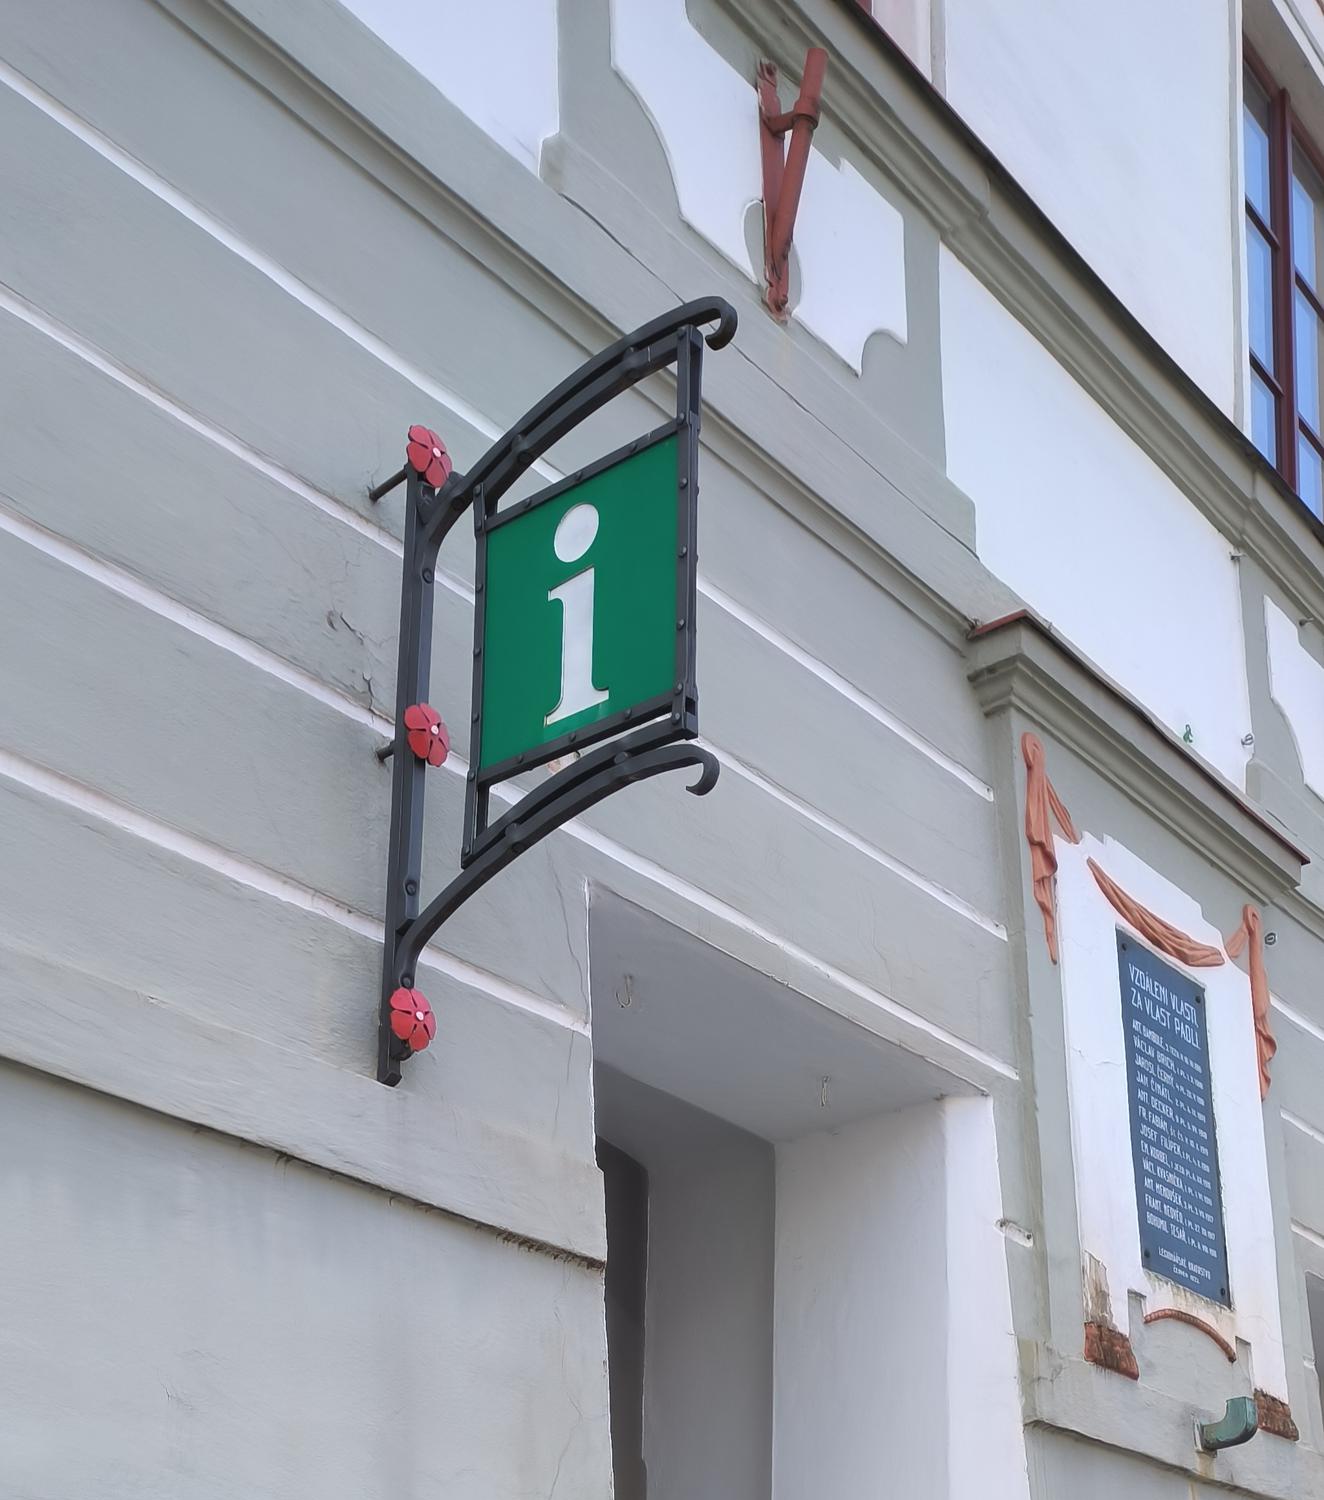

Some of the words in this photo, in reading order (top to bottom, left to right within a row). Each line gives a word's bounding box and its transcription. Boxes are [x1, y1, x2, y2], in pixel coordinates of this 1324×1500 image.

[544, 503, 609, 727] i
[1131, 987, 1142, 1011] ZA
[1145, 996, 1171, 1030] VLAST
